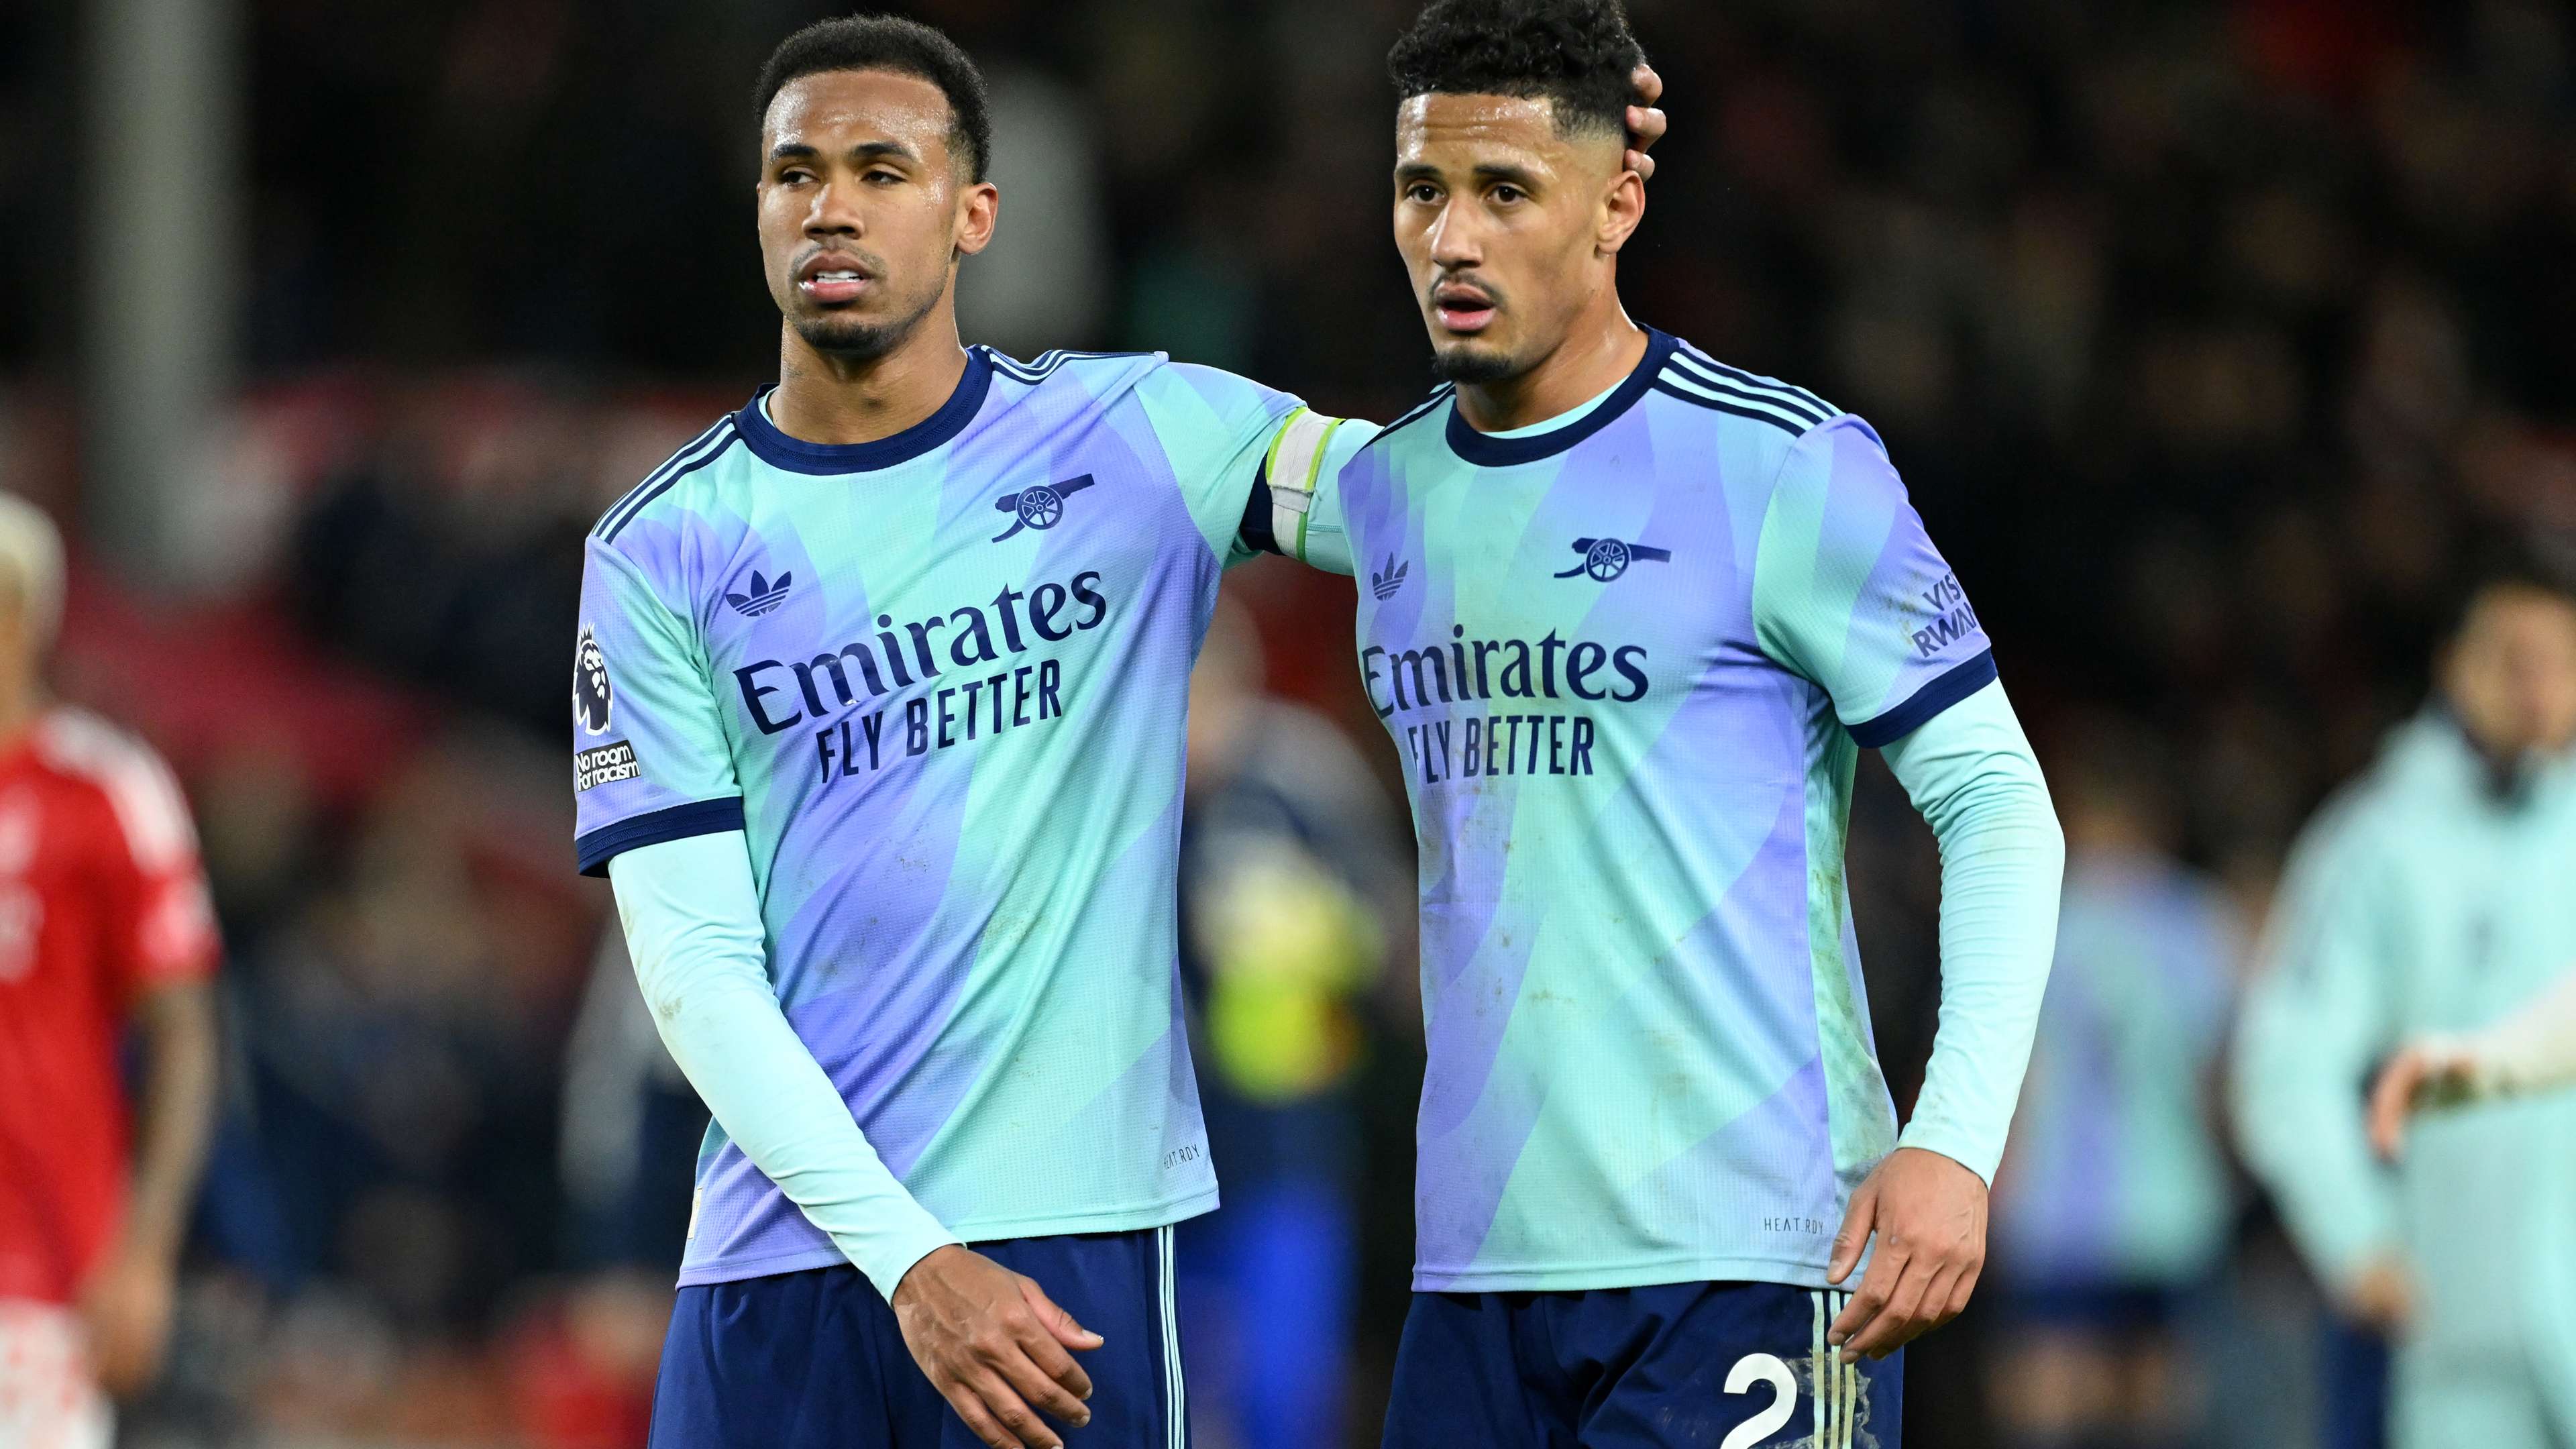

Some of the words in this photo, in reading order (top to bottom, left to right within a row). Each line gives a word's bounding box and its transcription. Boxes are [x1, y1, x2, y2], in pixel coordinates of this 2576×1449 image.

[733, 571, 1107, 735] Emirates
[1362, 624, 1649, 720] Emirates
[816, 710, 883, 784] FLY
[906, 659, 1062, 757] BETTER
[1407, 720, 1451, 784] FLY
[1463, 716, 1594, 777] BETTER
[575, 753, 590, 772] No
[592, 745, 631, 768] room
[592, 761, 640, 786] racism
[1764, 1218, 1823, 1235] HEAT.RDY
